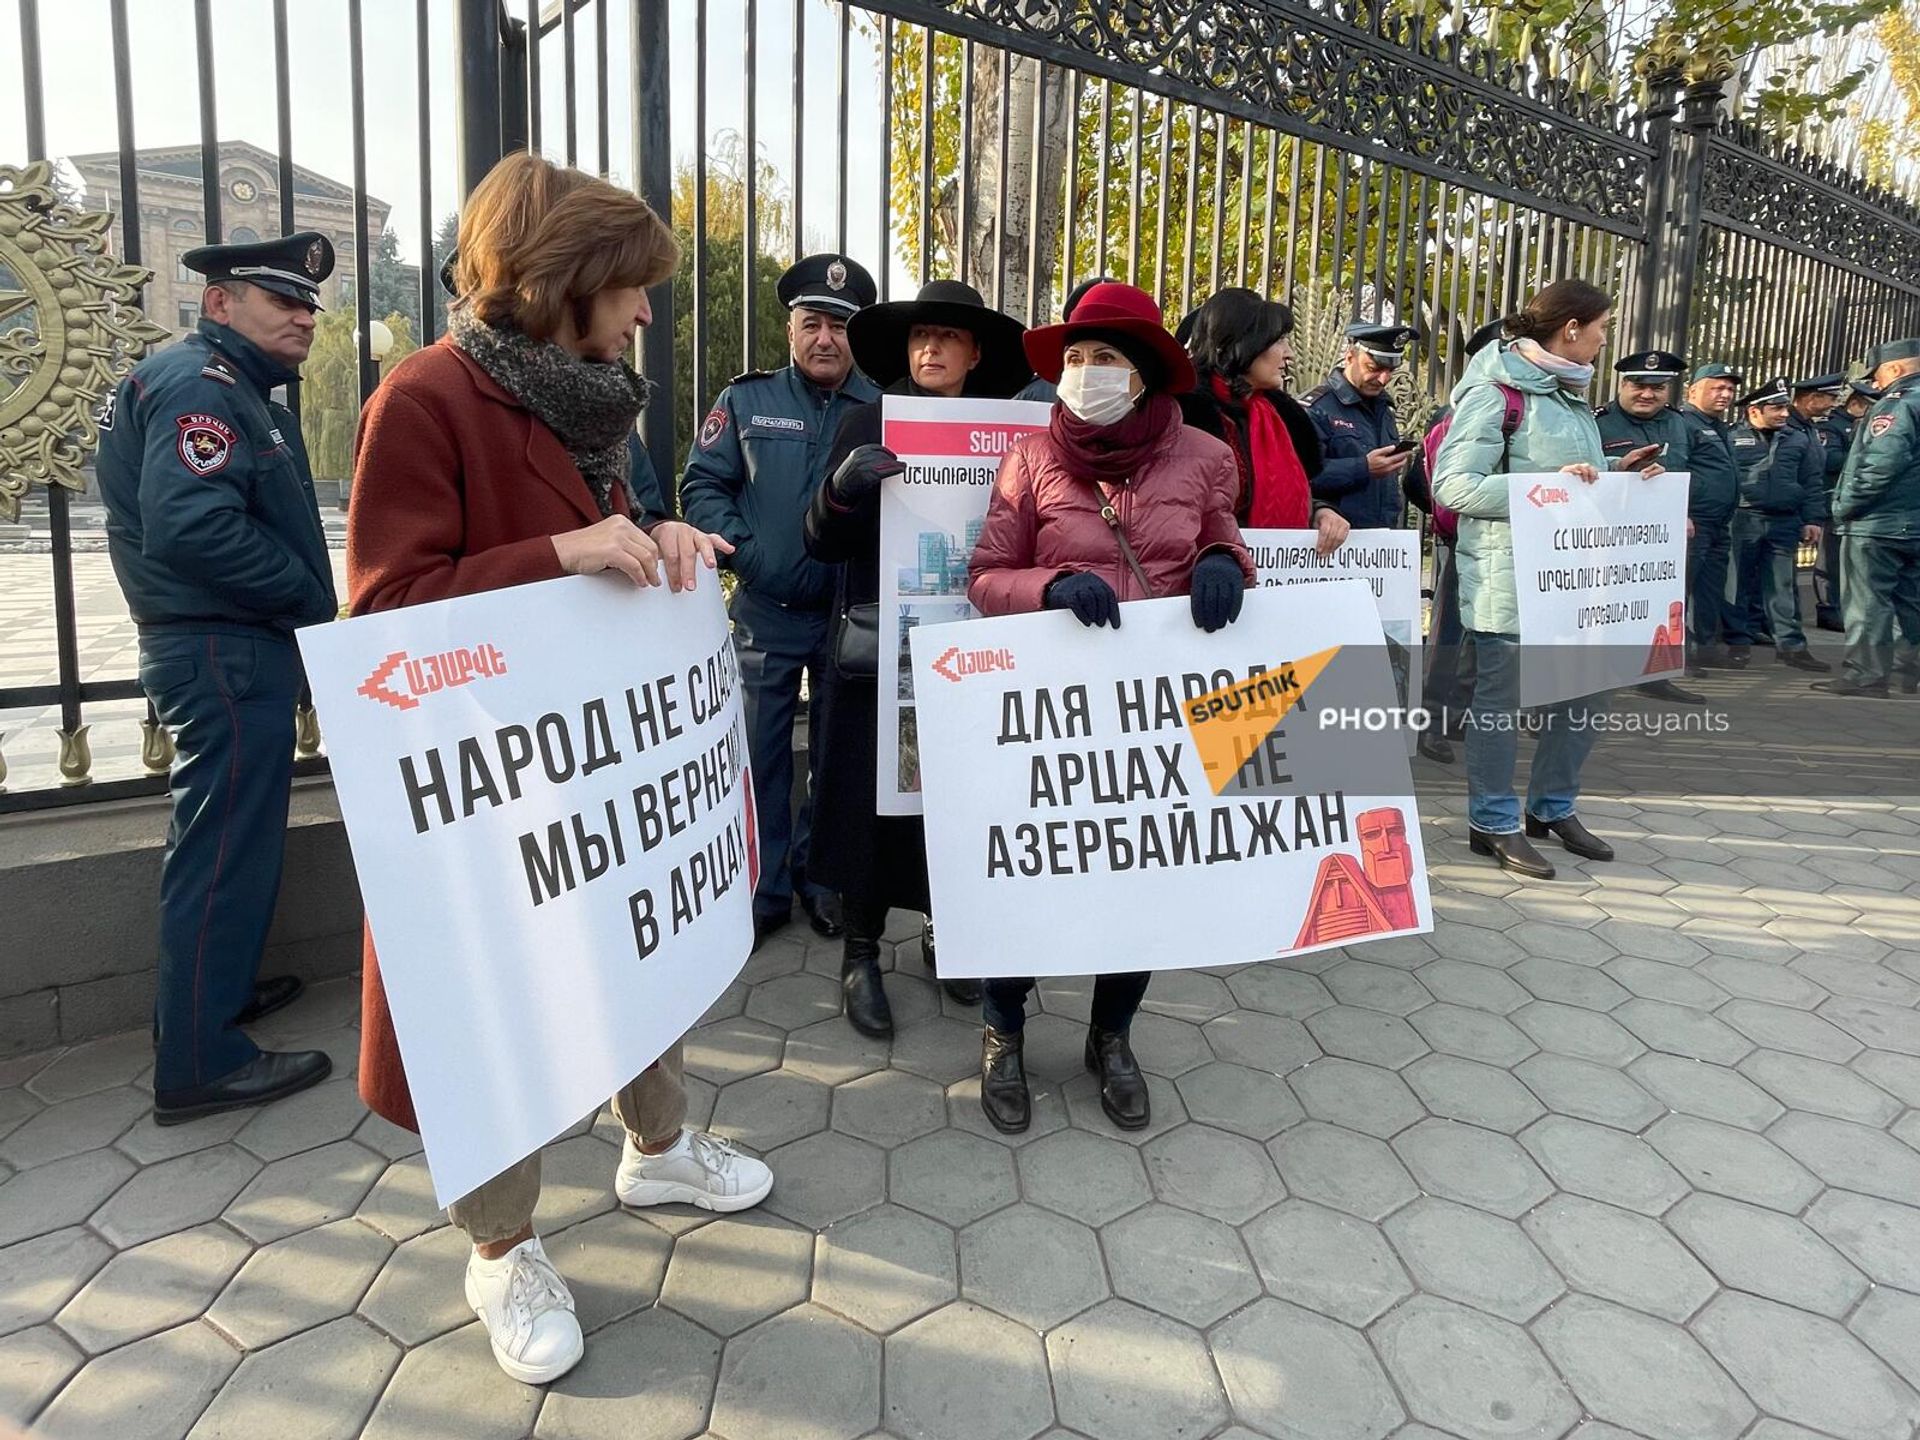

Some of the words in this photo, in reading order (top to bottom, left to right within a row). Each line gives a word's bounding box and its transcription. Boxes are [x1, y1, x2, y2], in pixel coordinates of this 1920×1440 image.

[903, 466, 999, 486] ՄՇԱԿՈՒԹԱՅԻ
[1554, 528, 1568, 550] ՀՀ
[996, 684, 1093, 745] ДЛЯ
[1115, 660, 1308, 735] НАРОДА
[398, 697, 623, 834] НАРОД
[625, 674, 683, 754] НЕ
[1029, 742, 1191, 809] АРЦАХ
[1232, 730, 1294, 789] НЕ
[518, 800, 627, 907] МЫ
[986, 790, 1350, 879] АЗЕРБАЙДЖАН
[628, 888, 660, 961] В
[670, 808, 746, 936] АРЦАХ
